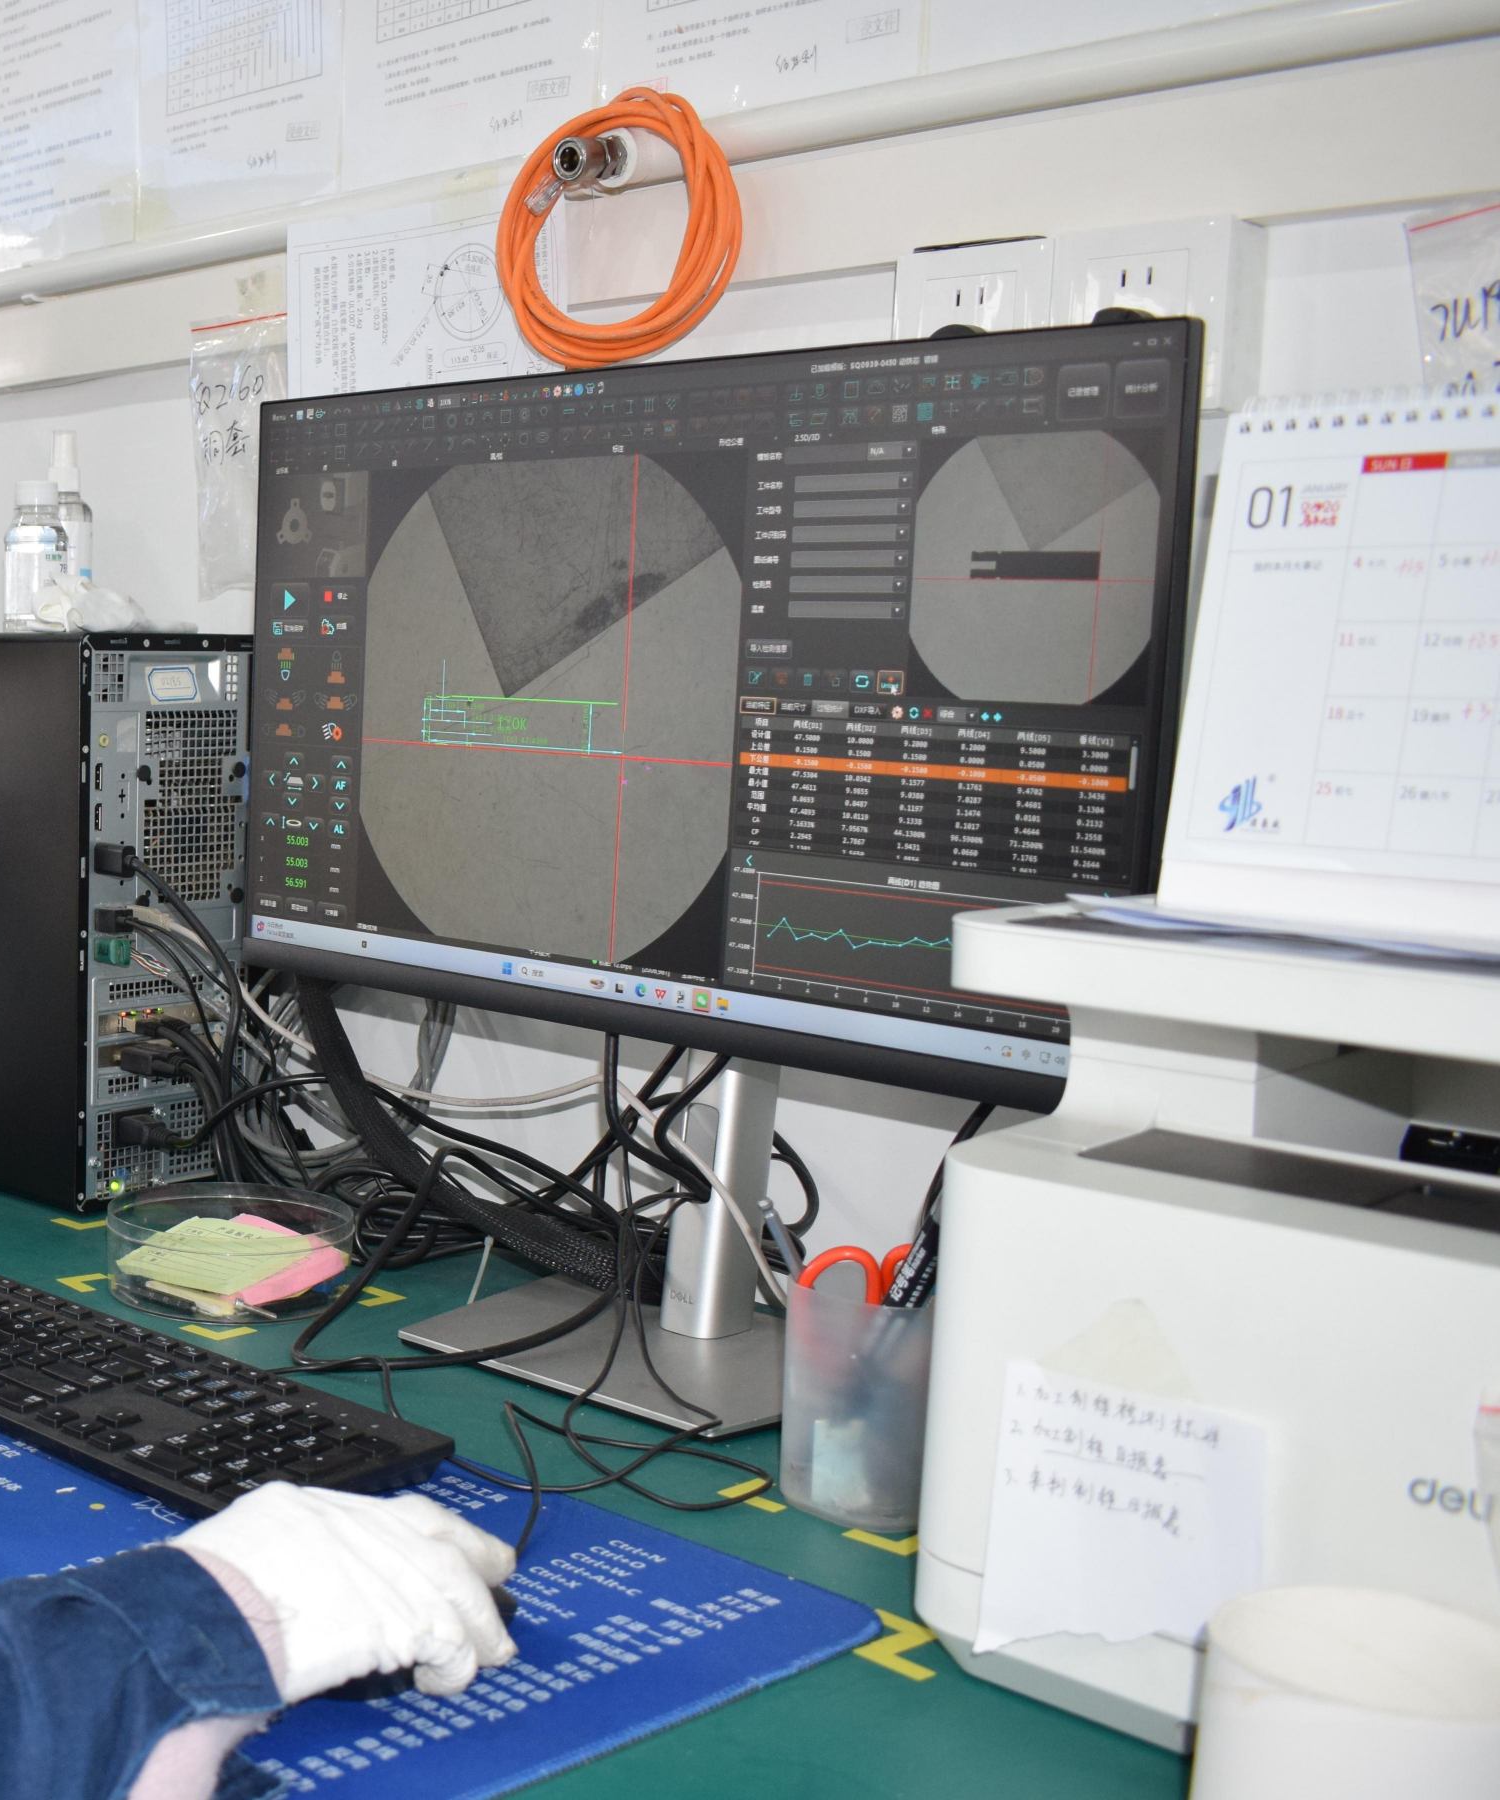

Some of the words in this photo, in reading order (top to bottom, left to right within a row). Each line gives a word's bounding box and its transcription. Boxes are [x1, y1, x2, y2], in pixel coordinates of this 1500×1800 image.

[1371, 457, 1396, 471] SUN
[1248, 485, 1293, 529] 01
[751, 731, 771, 739] 设计值
[750, 743, 770, 751] 上公差
[750, 755, 770, 764] 下公差
[335, 780, 346, 790] AF
[333, 824, 344, 834] AL
[286, 835, 309, 847] 55.003
[286, 856, 308, 868] 55.003
[285, 877, 307, 888] 56.591
[589, 1546, 647, 1569] Ctrl+O
[608, 1539, 667, 1563] Ctrl+N
[569, 1552, 633, 1577] Ctrl+W
[508, 1572, 561, 1596] Ctrl+Z
[528, 1566, 583, 1589] Ctrl+X
[550, 1558, 643, 1597] Ctrl+Alt+C
